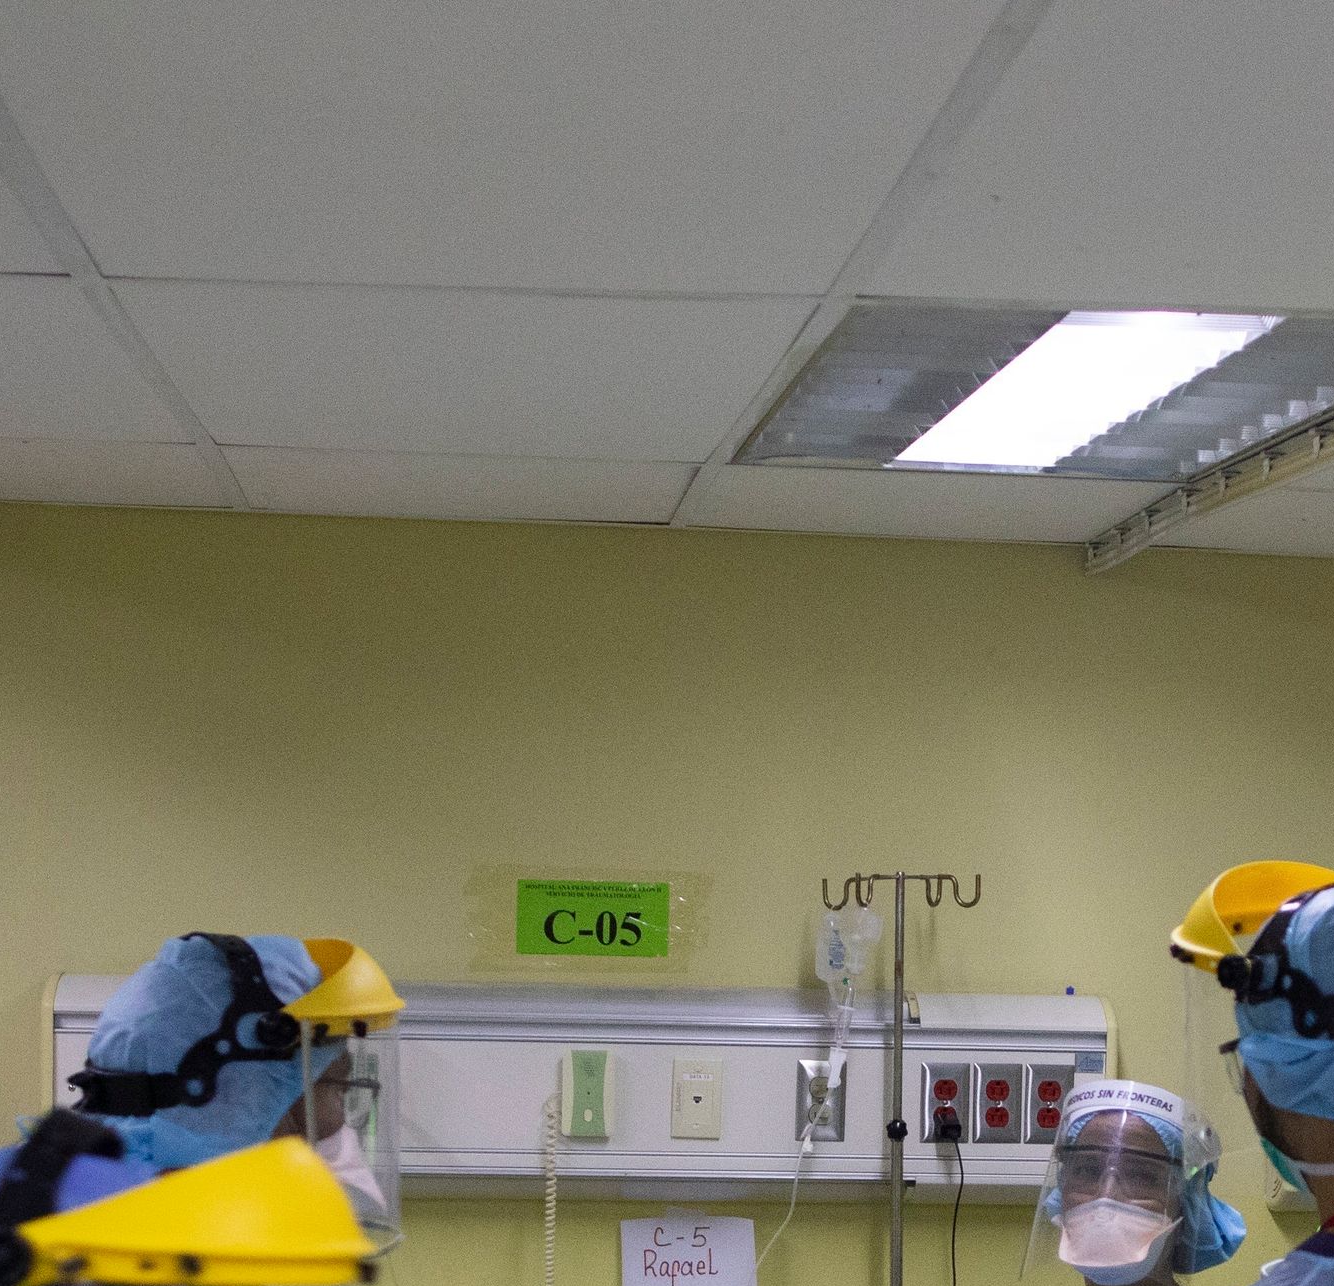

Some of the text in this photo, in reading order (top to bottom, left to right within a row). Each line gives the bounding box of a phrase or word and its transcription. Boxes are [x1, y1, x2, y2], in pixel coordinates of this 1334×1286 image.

[544, 909, 642, 946] C-05
[1097, 1089, 1115, 1099] SIN
[1116, 1090, 1174, 1112] FRONTERAS
